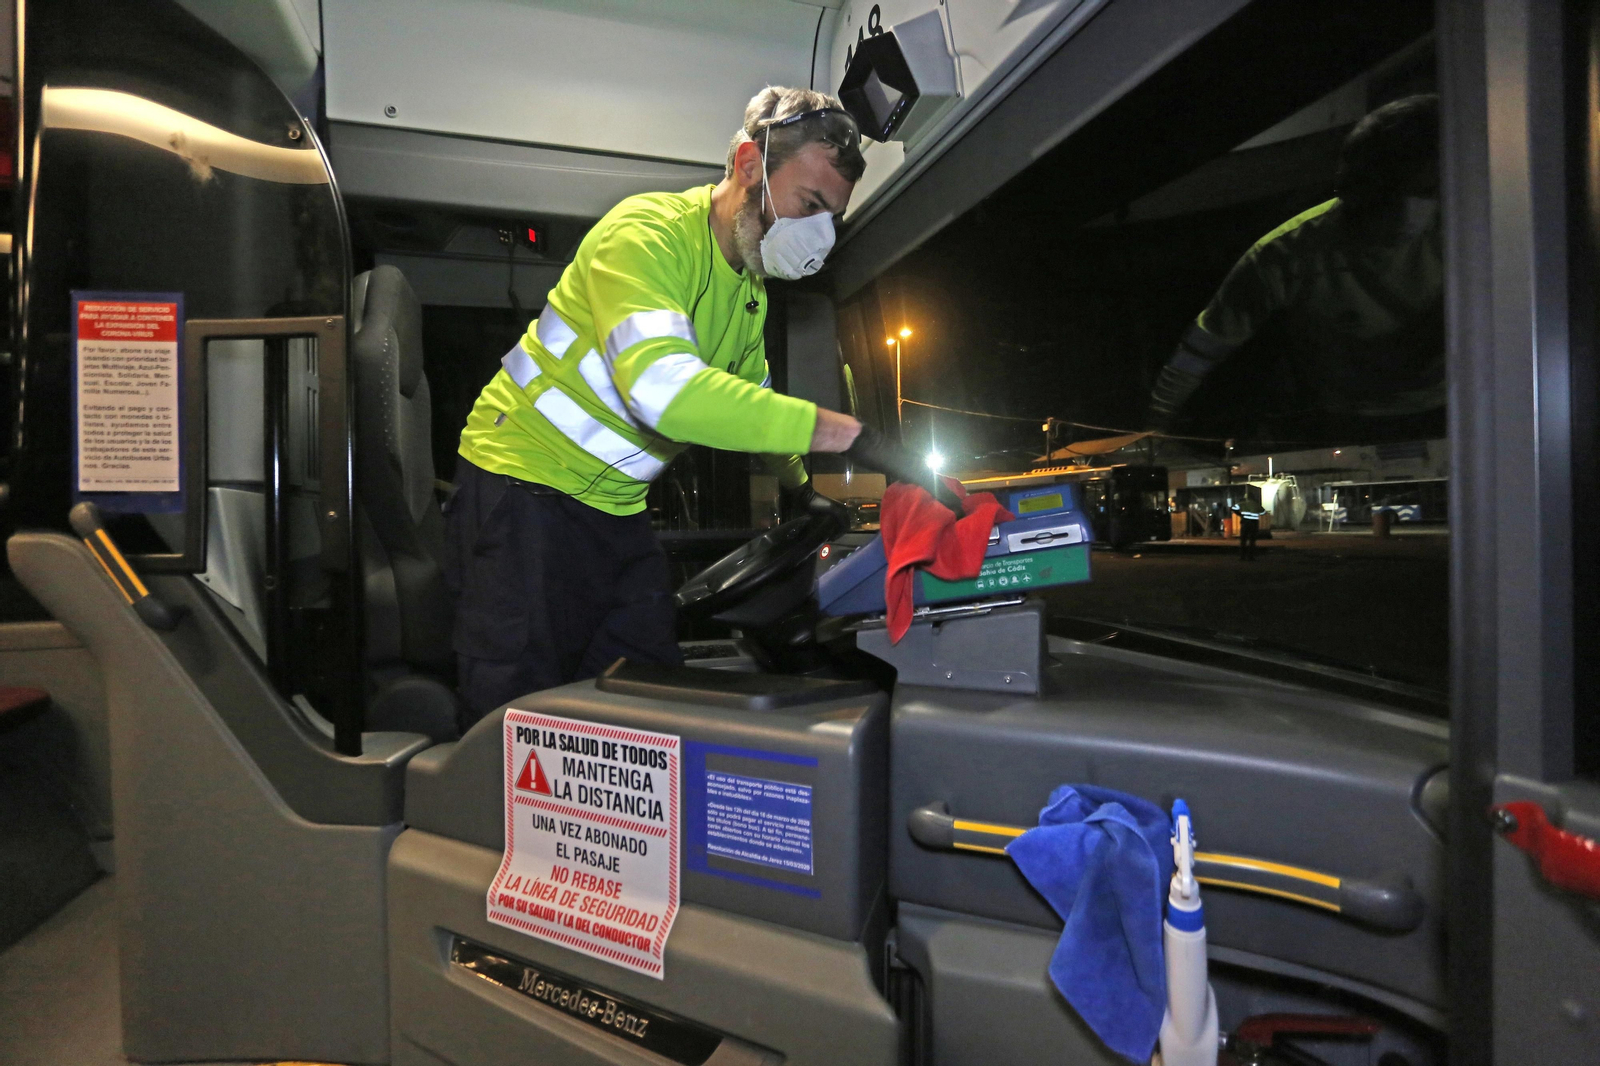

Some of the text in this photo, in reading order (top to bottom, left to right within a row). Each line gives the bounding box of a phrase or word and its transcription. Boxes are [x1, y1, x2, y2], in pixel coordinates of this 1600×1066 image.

[1003, 557, 1033, 566] Transportes
[516, 726, 667, 770] POR LA SALUD DE TODOS
[563, 757, 653, 793] MANTENGA
[736, 779, 763, 788] transporte
[764, 783, 784, 792] público
[554, 779, 663, 821] LA DISTANCIA
[532, 814, 647, 856] UNA VEZ ABONADO
[707, 843, 734, 854] Resolución
[708, 830, 748, 843] establecimientos
[722, 826, 742, 834] abiertos
[762, 834, 780, 842] horario
[782, 838, 801, 846] normal
[556, 842, 620, 873] EL PASAJE
[550, 865, 622, 899] NO REBASE
[504, 874, 658, 932] LA LÍNEA DE SEGURIDAD
[498, 894, 652, 952] POR SU SALUD Y LA DEL CONDUCTOR
[518, 968, 649, 1038] Mercedes-Benz
